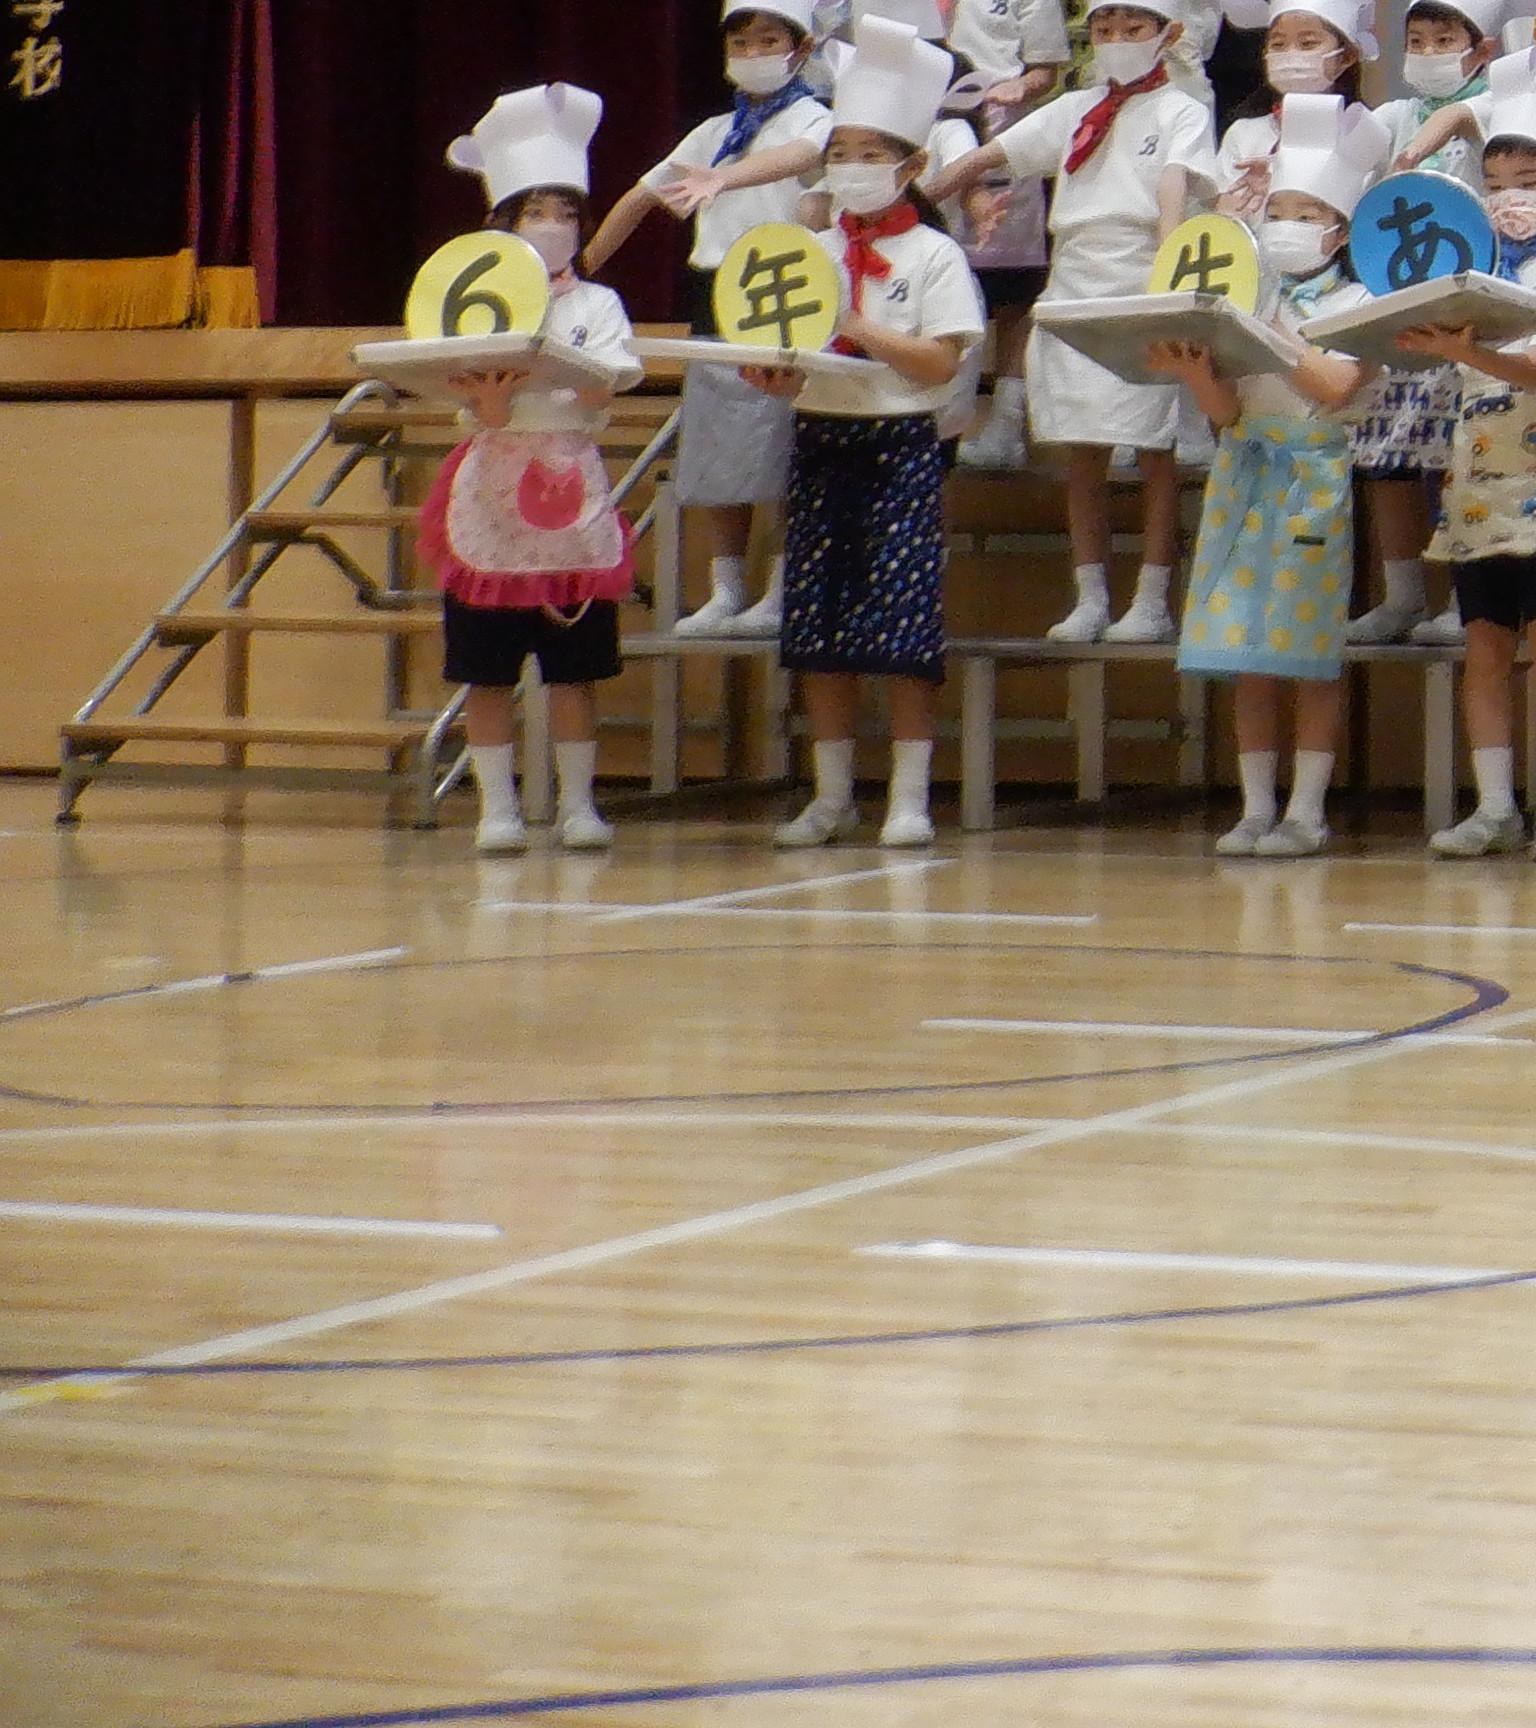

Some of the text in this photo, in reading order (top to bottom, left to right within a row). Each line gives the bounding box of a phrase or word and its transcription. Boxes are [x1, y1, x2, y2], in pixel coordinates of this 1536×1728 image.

[1377, 196, 1474, 289] あ
[442, 251, 512, 336] 6
[737, 246, 823, 348] 年
